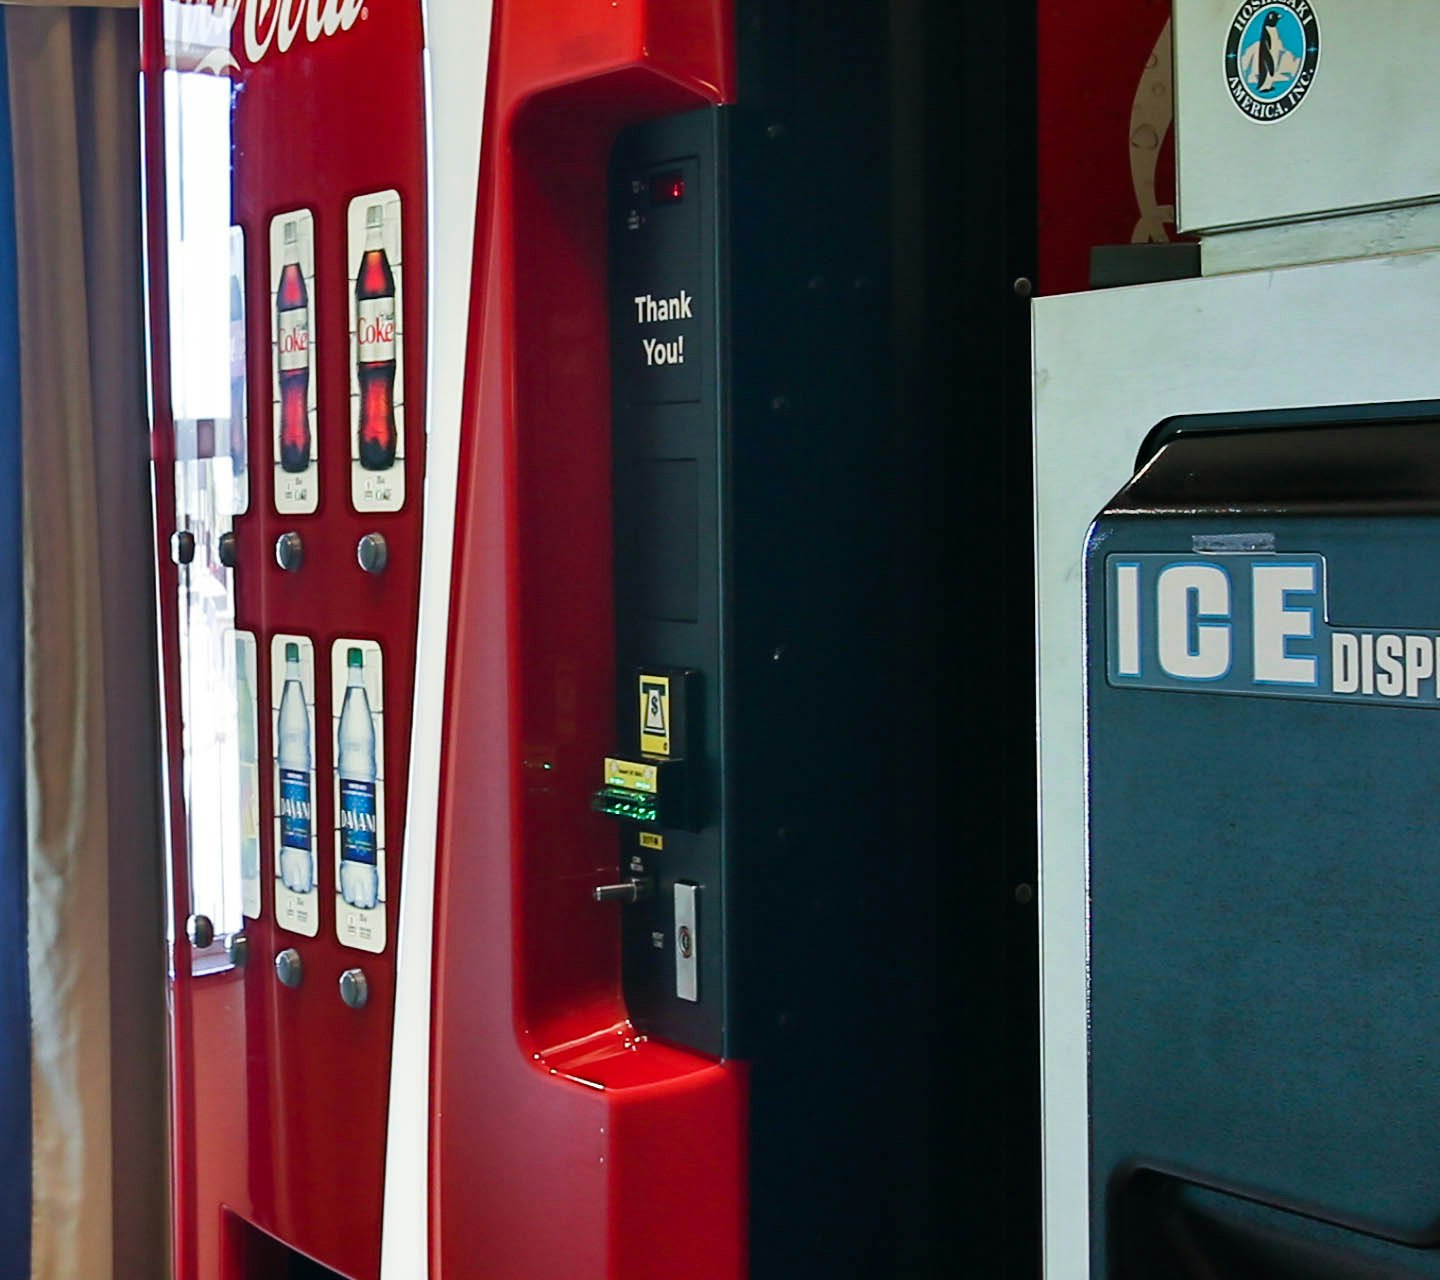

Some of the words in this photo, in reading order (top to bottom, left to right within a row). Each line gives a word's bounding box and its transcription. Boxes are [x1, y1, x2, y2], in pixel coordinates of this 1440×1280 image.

[1288, 68, 1314, 105] INC.
[634, 289, 693, 324] Thank
[356, 316, 397, 345] Coke
[642, 335, 685, 366] You!
[1115, 562, 1318, 686] ICE
